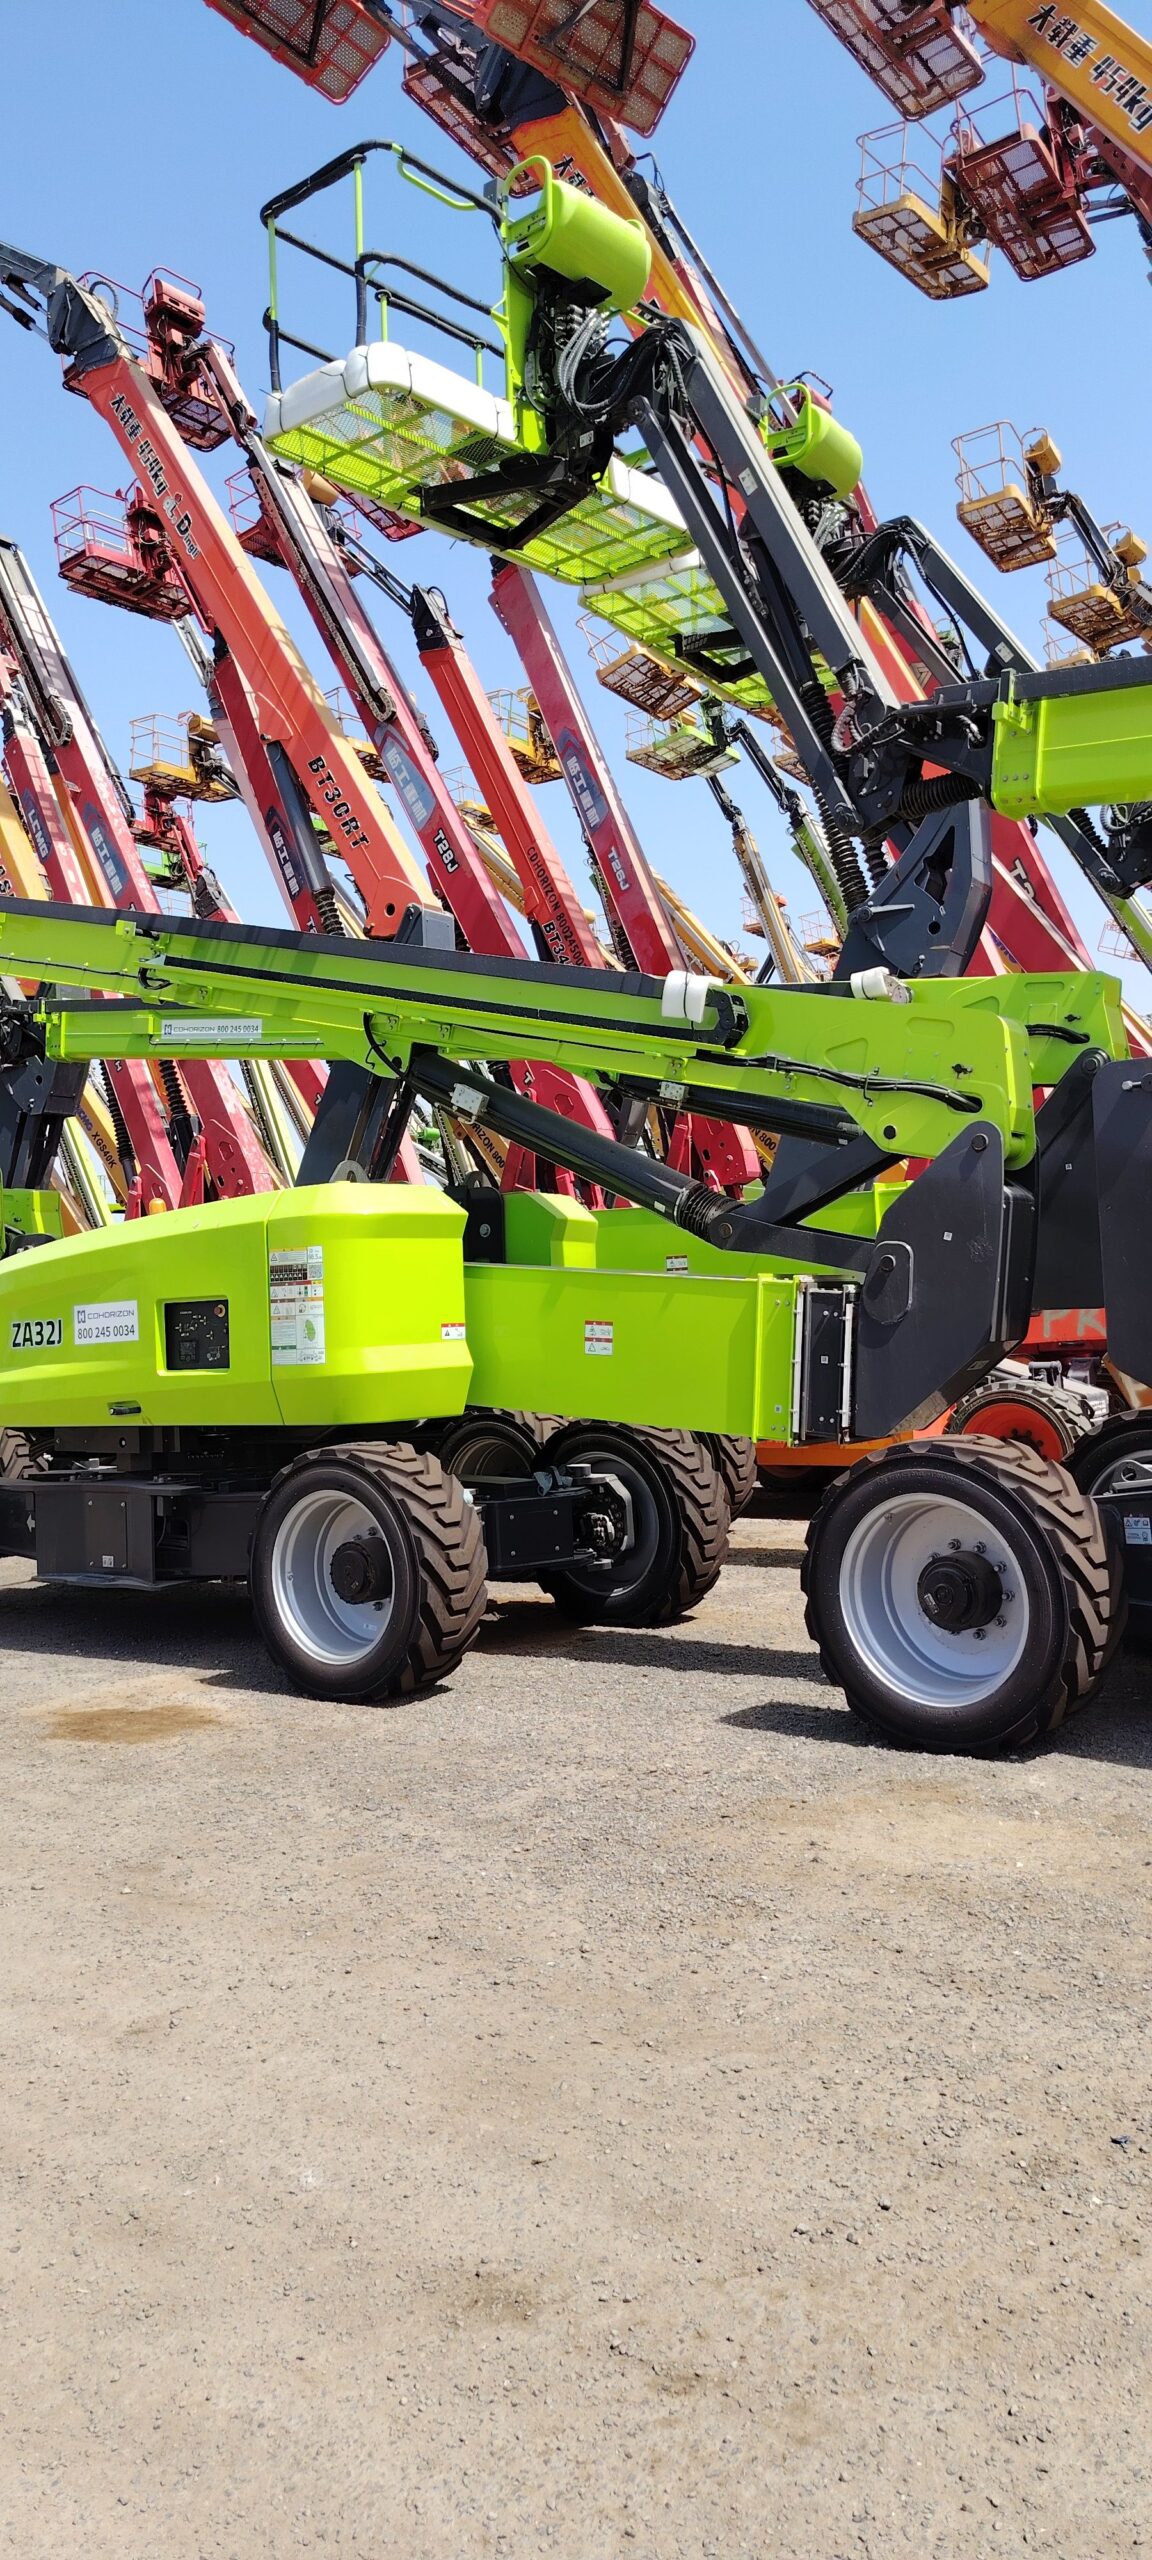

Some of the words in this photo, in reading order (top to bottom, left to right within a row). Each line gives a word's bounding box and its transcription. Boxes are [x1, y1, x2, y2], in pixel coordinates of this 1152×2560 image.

[138, 439, 170, 499] 454kg
[175, 511, 201, 560] Dingli
[308, 755, 371, 848] BT30RT
[433, 828, 460, 875] T28J
[542, 921, 571, 967] BT34
[556, 912, 587, 967] 80024500
[216, 1025, 228, 1033] 800
[230, 1025, 242, 1033] 245
[243, 1025, 259, 1033] 0034
[91, 1130, 118, 1169] XGS40K
[12, 1319, 62, 1348] ZA32J
[77, 1327, 93, 1340] 800
[95, 1326, 111, 1338] 245
[112, 1324, 135, 1337] 0034
